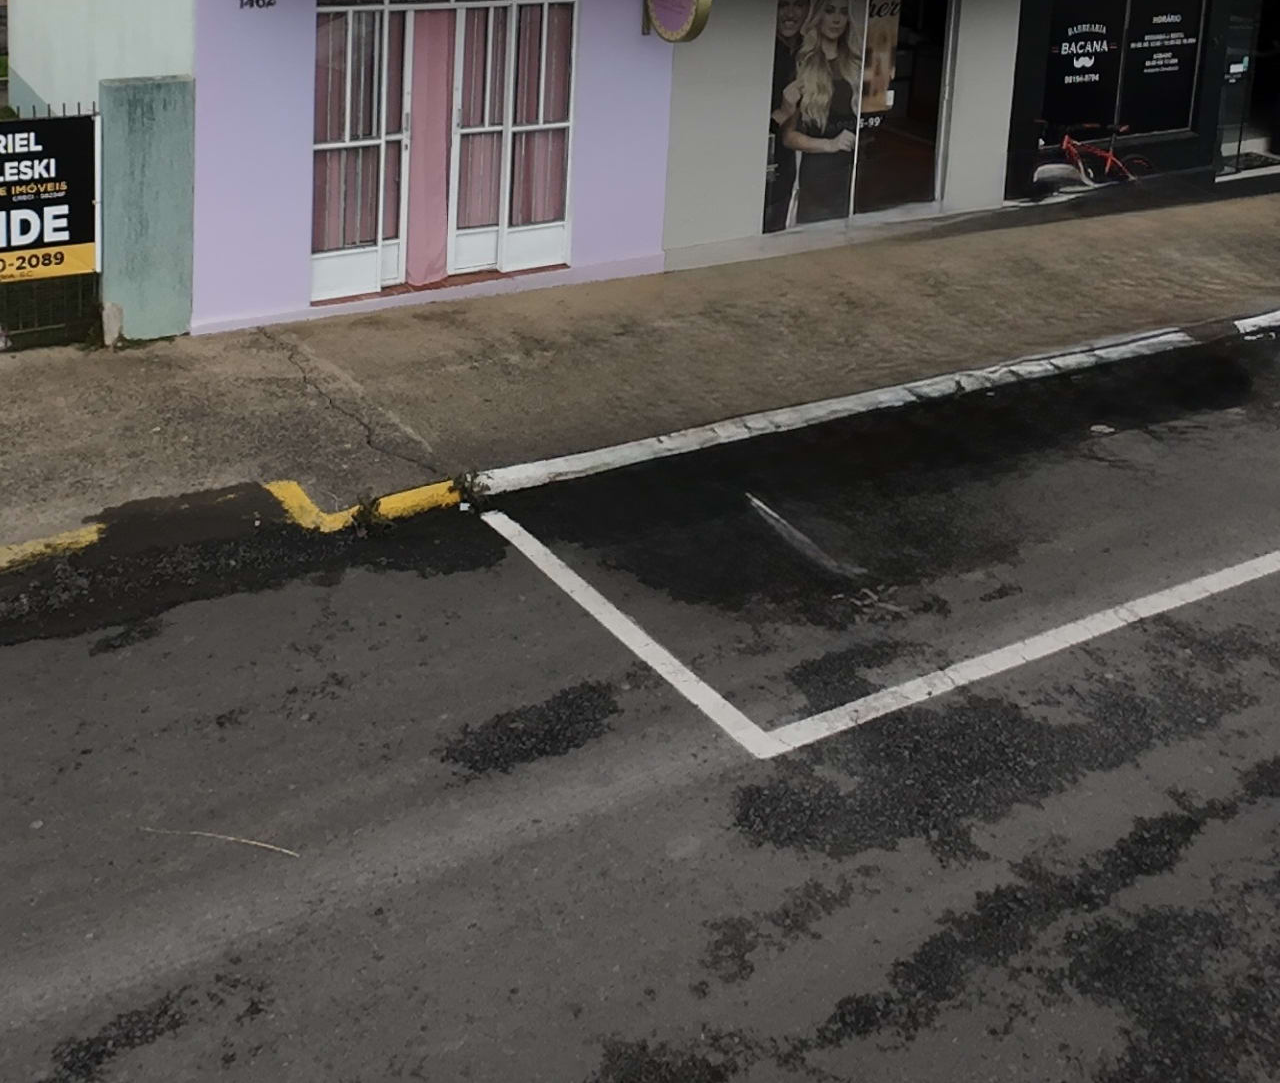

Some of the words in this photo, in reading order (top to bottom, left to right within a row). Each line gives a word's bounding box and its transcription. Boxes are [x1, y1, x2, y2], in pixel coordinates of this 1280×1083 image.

[1067, 23, 1107, 36] BARBEARIA
[1061, 39, 1109, 55] BACANA
[11, 181, 68, 195] IMÓVEIS
